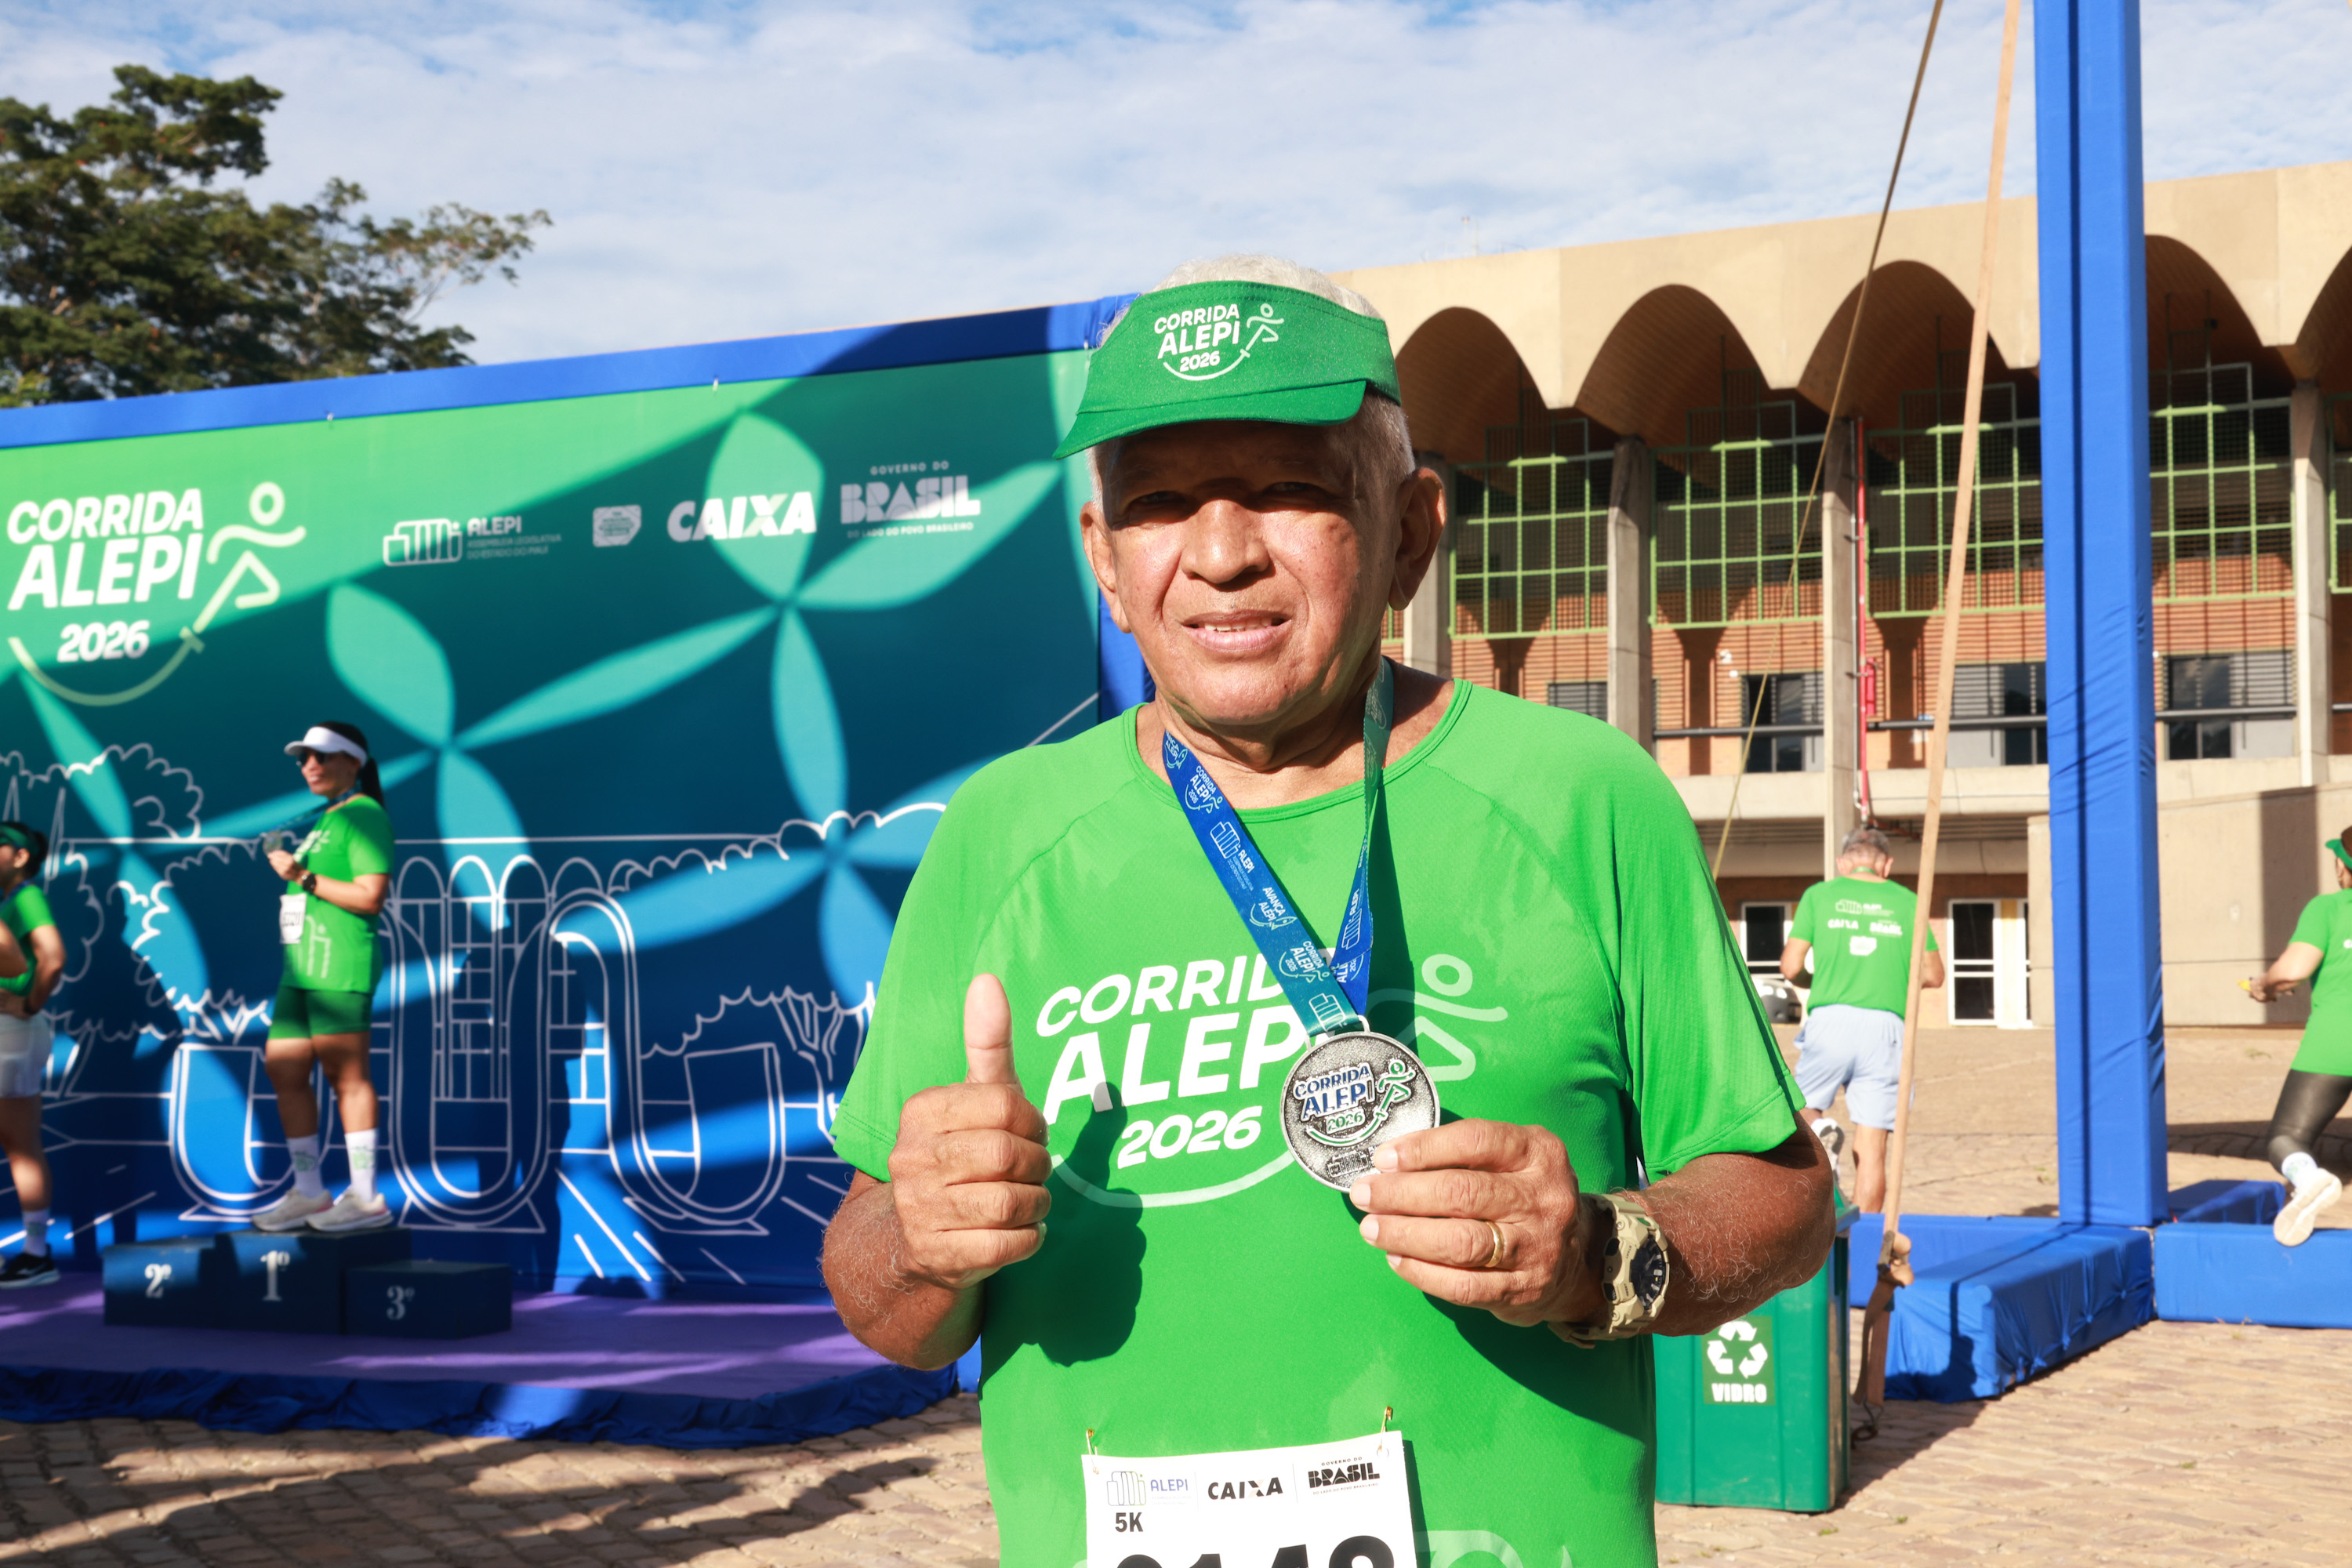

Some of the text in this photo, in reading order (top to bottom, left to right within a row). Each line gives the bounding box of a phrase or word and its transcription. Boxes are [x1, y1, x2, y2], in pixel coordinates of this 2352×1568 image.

[1154, 303, 1240, 334] CORRIDA
[1157, 321, 1240, 359] ALEPI
[1180, 350, 1220, 372] 2026
[870, 460, 949, 476] GOVERNO DO
[840, 475, 981, 524] BRASIL
[7, 488, 204, 544] CORRIDA
[467, 516, 522, 536] ALEPI
[667, 491, 817, 543] CAIXA
[7, 533, 204, 611] ALEPI
[56, 620, 150, 662] 2026
[1190, 775, 1212, 803] ALEPI
[1196, 765, 1217, 794] CORRIDA
[1189, 789, 1199, 804] 2026
[1238, 849, 1255, 873] ALEPI
[1258, 902, 1276, 921] ALEPI
[1262, 887, 1286, 916] AVANÇA
[1290, 947, 1316, 973] ALEPI
[1303, 941, 1324, 969] CORRIDA
[1044, 1004, 1325, 1125] ALEP
[1295, 1065, 1371, 1098] CORRIDA
[1302, 1080, 1374, 1120] ALEPI
[1327, 1110, 1363, 1131] 2026
[1117, 1105, 1263, 1169] 2026
[1711, 1382, 1767, 1403] VIDRO
[1308, 1462, 1380, 1489] BRASIL
[1321, 1457, 1351, 1466] GOVERNO
[1150, 1479, 1189, 1491] ALEPI
[1208, 1477, 1283, 1500] CAIXA
[1115, 1512, 1144, 1533] 5K
